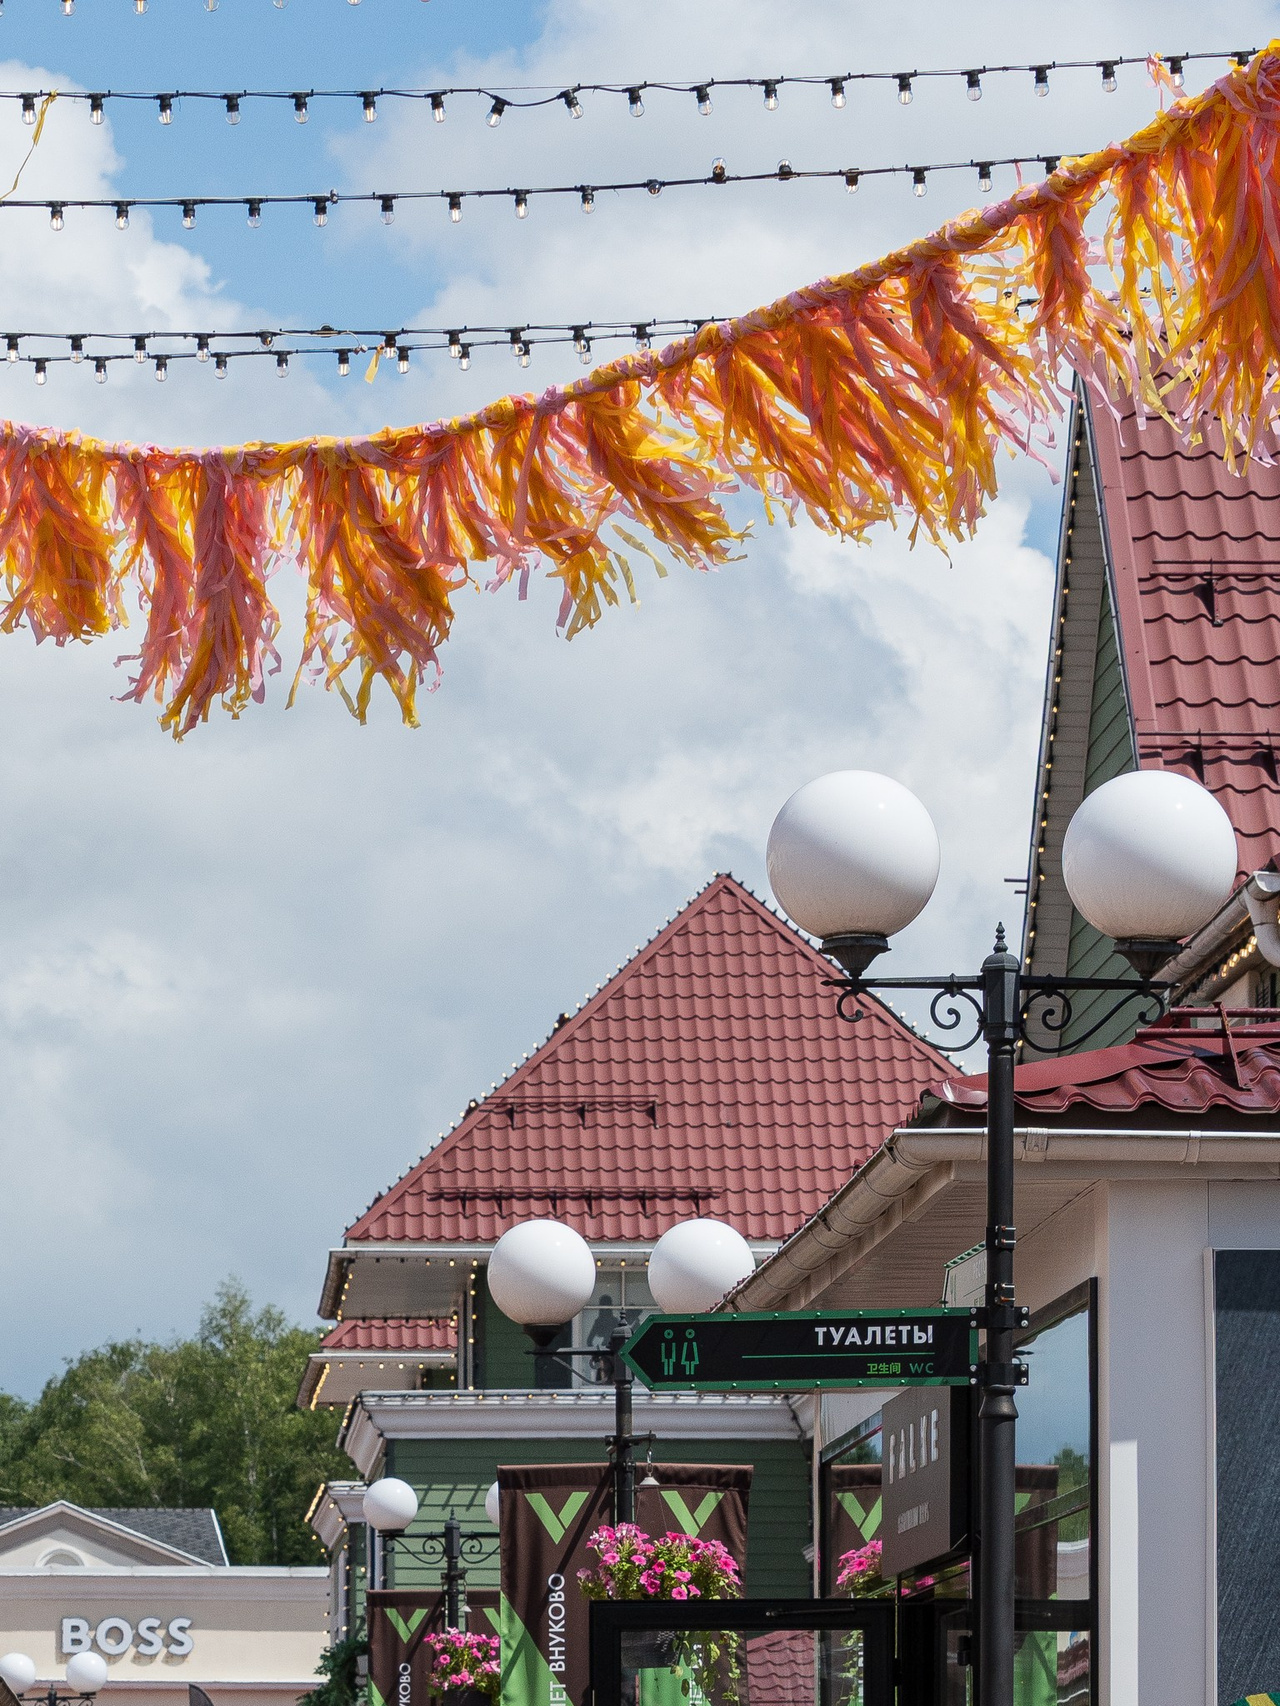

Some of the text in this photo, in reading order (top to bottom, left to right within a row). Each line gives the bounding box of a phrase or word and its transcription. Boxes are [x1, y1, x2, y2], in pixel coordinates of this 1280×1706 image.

[814, 1324, 934, 1346] ТУАЛЕТЫ
[866, 1361, 902, 1375] 卫生间
[909, 1362, 935, 1375] WC
[888, 1408, 940, 1485] FALKE
[61, 1616, 195, 1656] BOSS
[547, 1572, 567, 1673] ВНУКОВО
